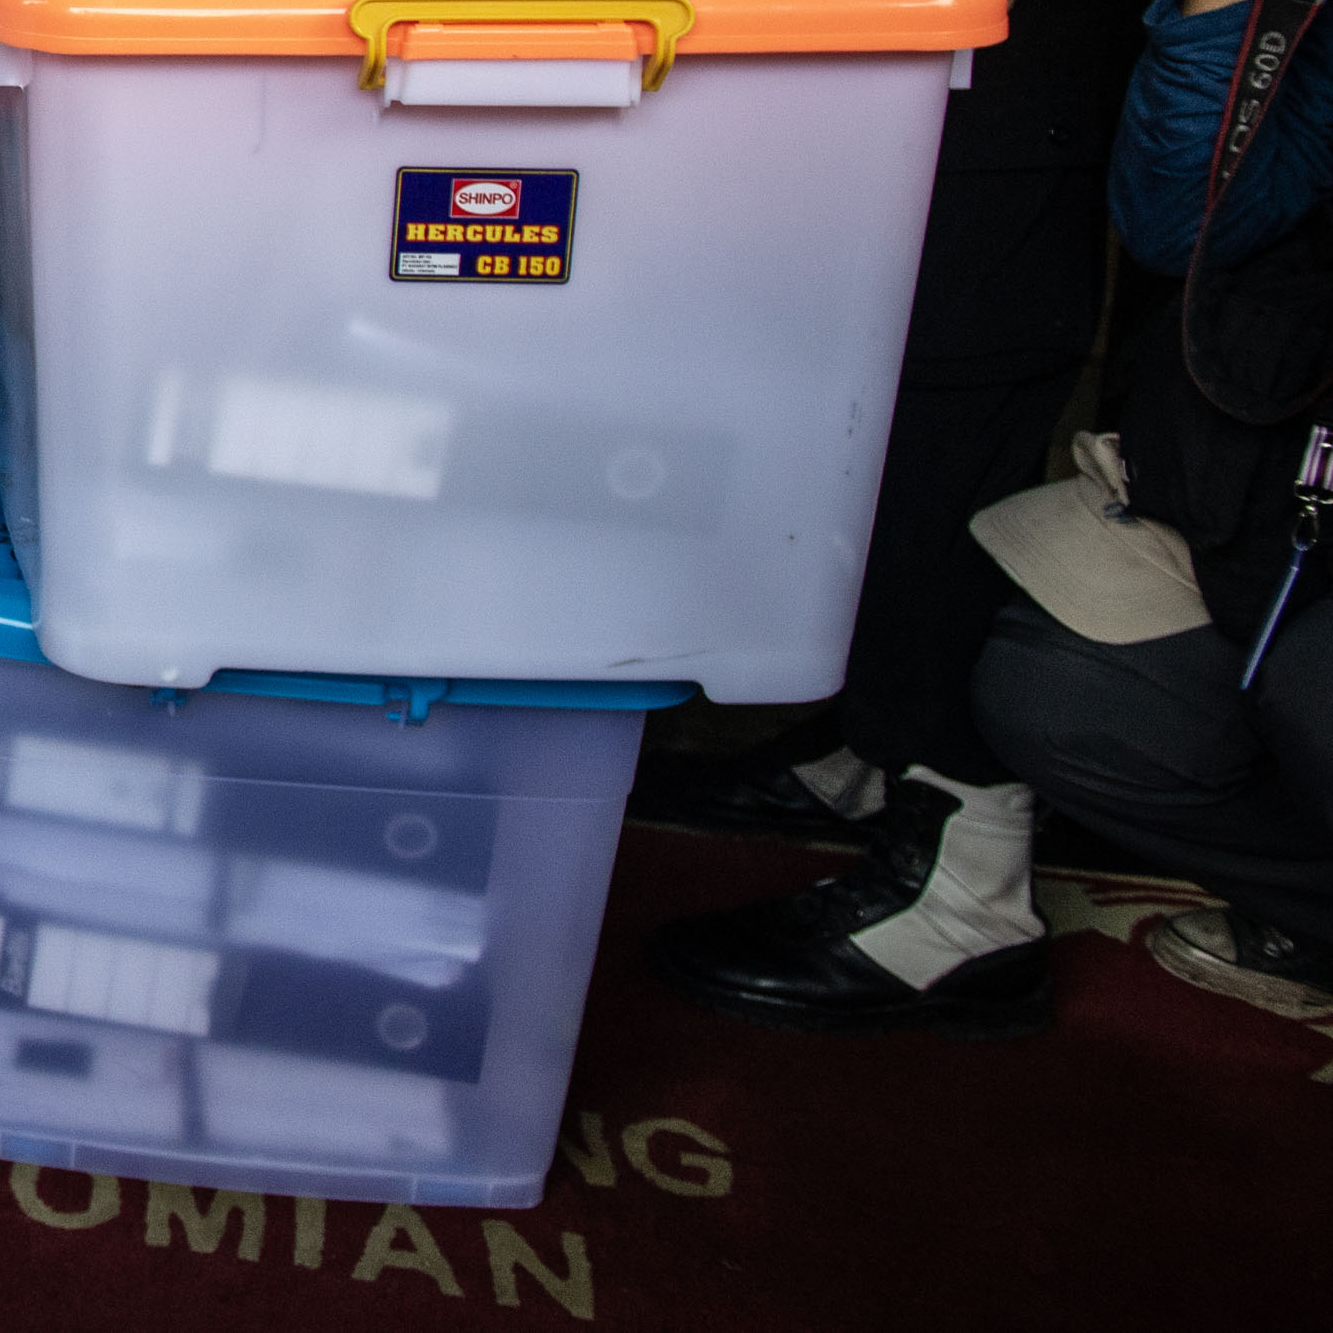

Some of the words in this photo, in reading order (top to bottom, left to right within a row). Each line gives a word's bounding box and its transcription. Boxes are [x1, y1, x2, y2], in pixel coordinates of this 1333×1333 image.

[1249, 30, 1287, 90] 60D
[458, 192, 514, 205] SHINPO
[406, 222, 560, 244] HERCULES
[476, 254, 510, 275] CB
[517, 256, 562, 277] 150
[559, 1110, 734, 1199] NG
